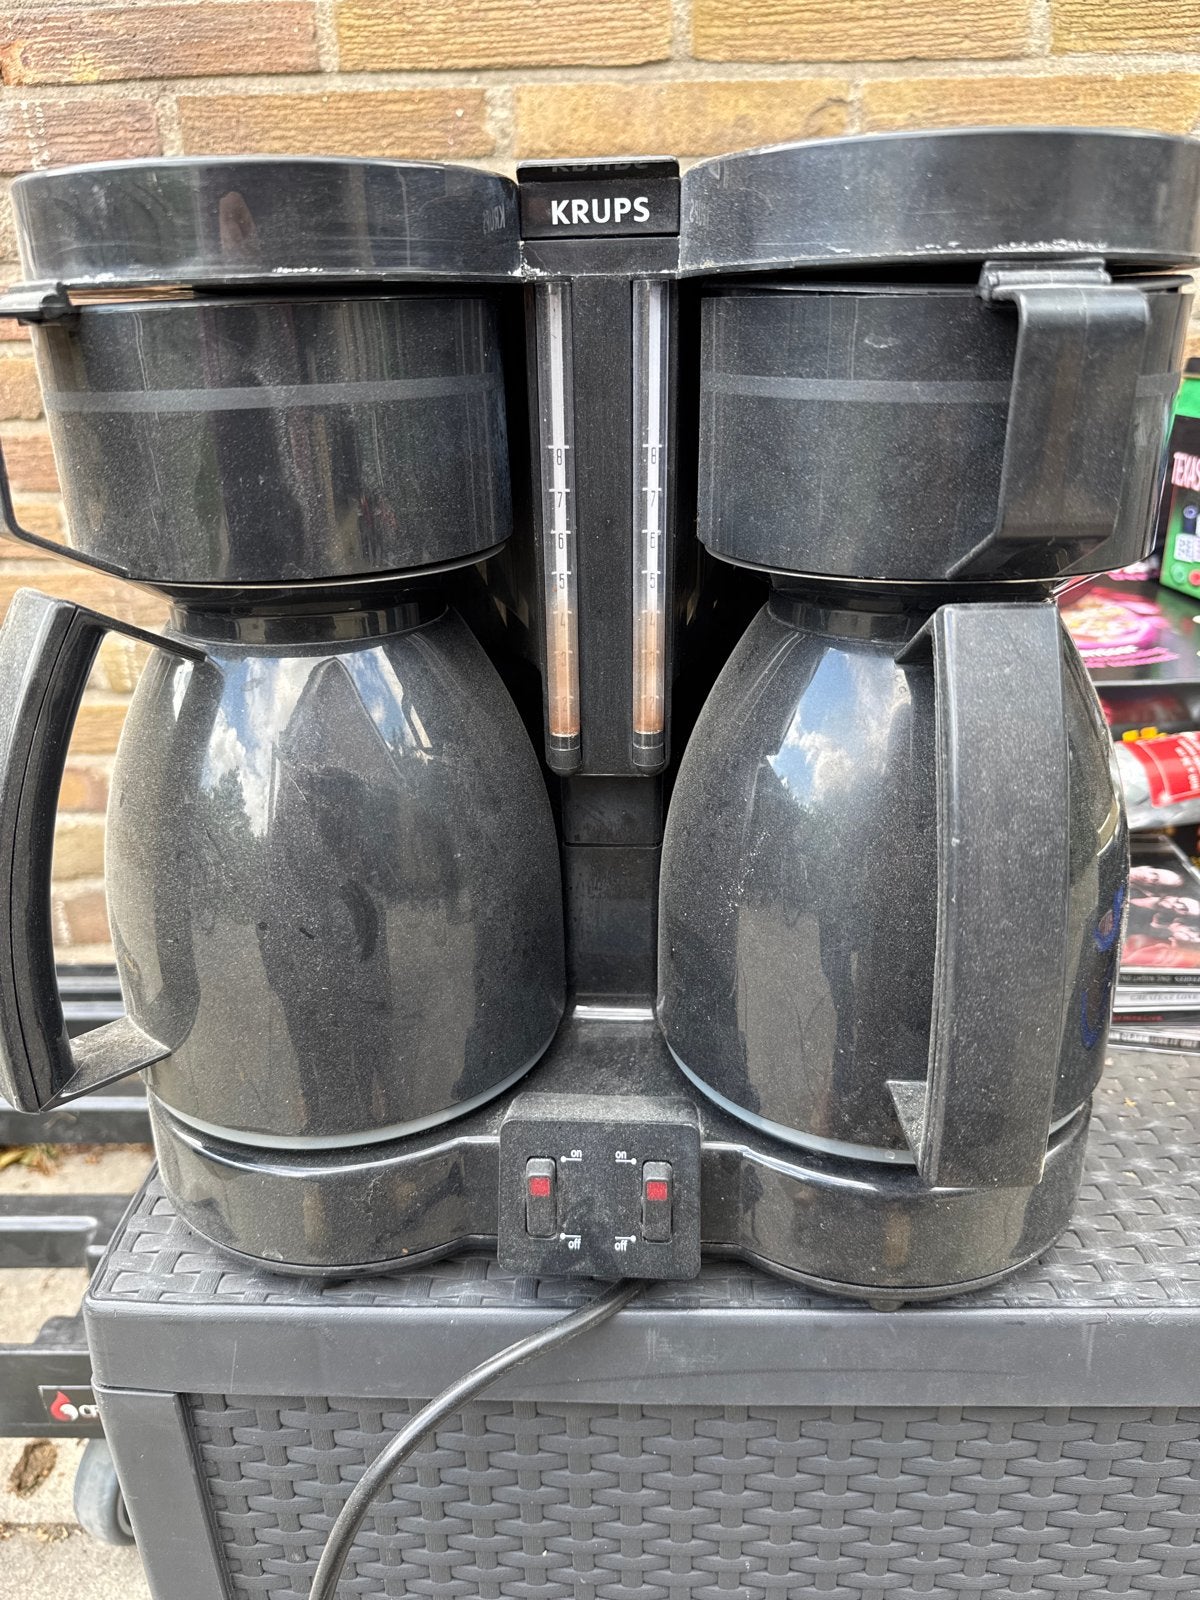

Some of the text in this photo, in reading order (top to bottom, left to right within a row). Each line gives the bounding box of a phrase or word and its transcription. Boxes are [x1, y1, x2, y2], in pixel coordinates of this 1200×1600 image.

[551, 196, 650, 225] KRUPS
[556, 448, 562, 466] 8
[651, 447, 657, 465] 8
[557, 491, 563, 508] 7
[650, 490, 656, 507] 7
[558, 533, 564, 550] 6
[559, 573, 565, 589] 5
[650, 573, 656, 589] 5
[570, 1149, 582, 1158] on
[615, 1150, 627, 1159] on
[568, 1239, 582, 1250] off
[614, 1240, 628, 1251] off
